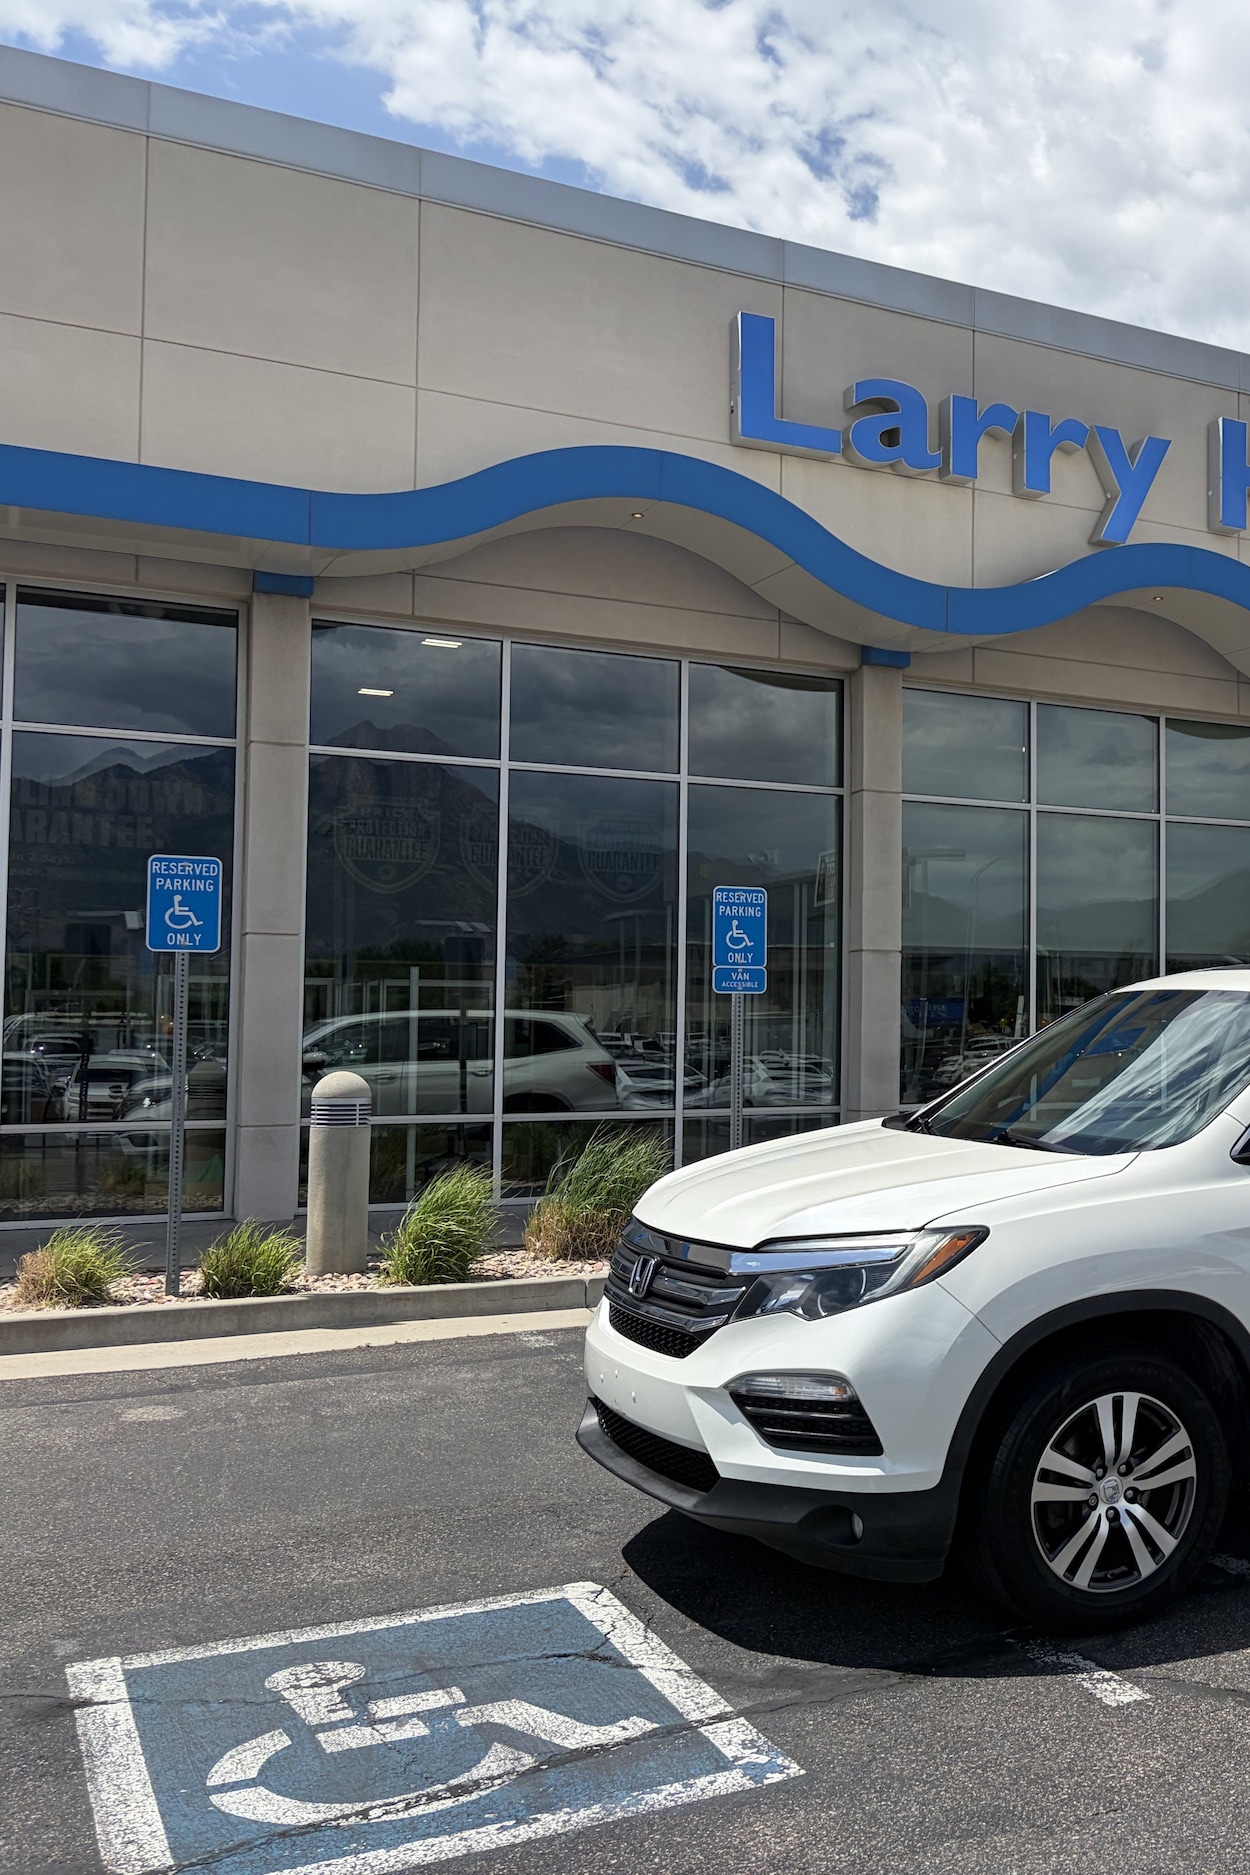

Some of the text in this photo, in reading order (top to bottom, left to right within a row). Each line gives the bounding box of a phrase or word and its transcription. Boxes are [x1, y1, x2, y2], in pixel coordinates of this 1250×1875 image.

[730, 310, 1171, 547] Larry
[474, 826, 547, 844] PROCTION
[346, 837, 427, 861] GUARANTEE
[472, 844, 548, 867] GUAANTEE
[152, 861, 218, 876] RESERVED
[156, 878, 214, 892] PARKING
[716, 892, 764, 904] RESERVED
[719, 906, 761, 917] PARKING
[167, 932, 202, 946] ONLY
[727, 952, 753, 963] ONLY
[731, 972, 750, 980] VAN
